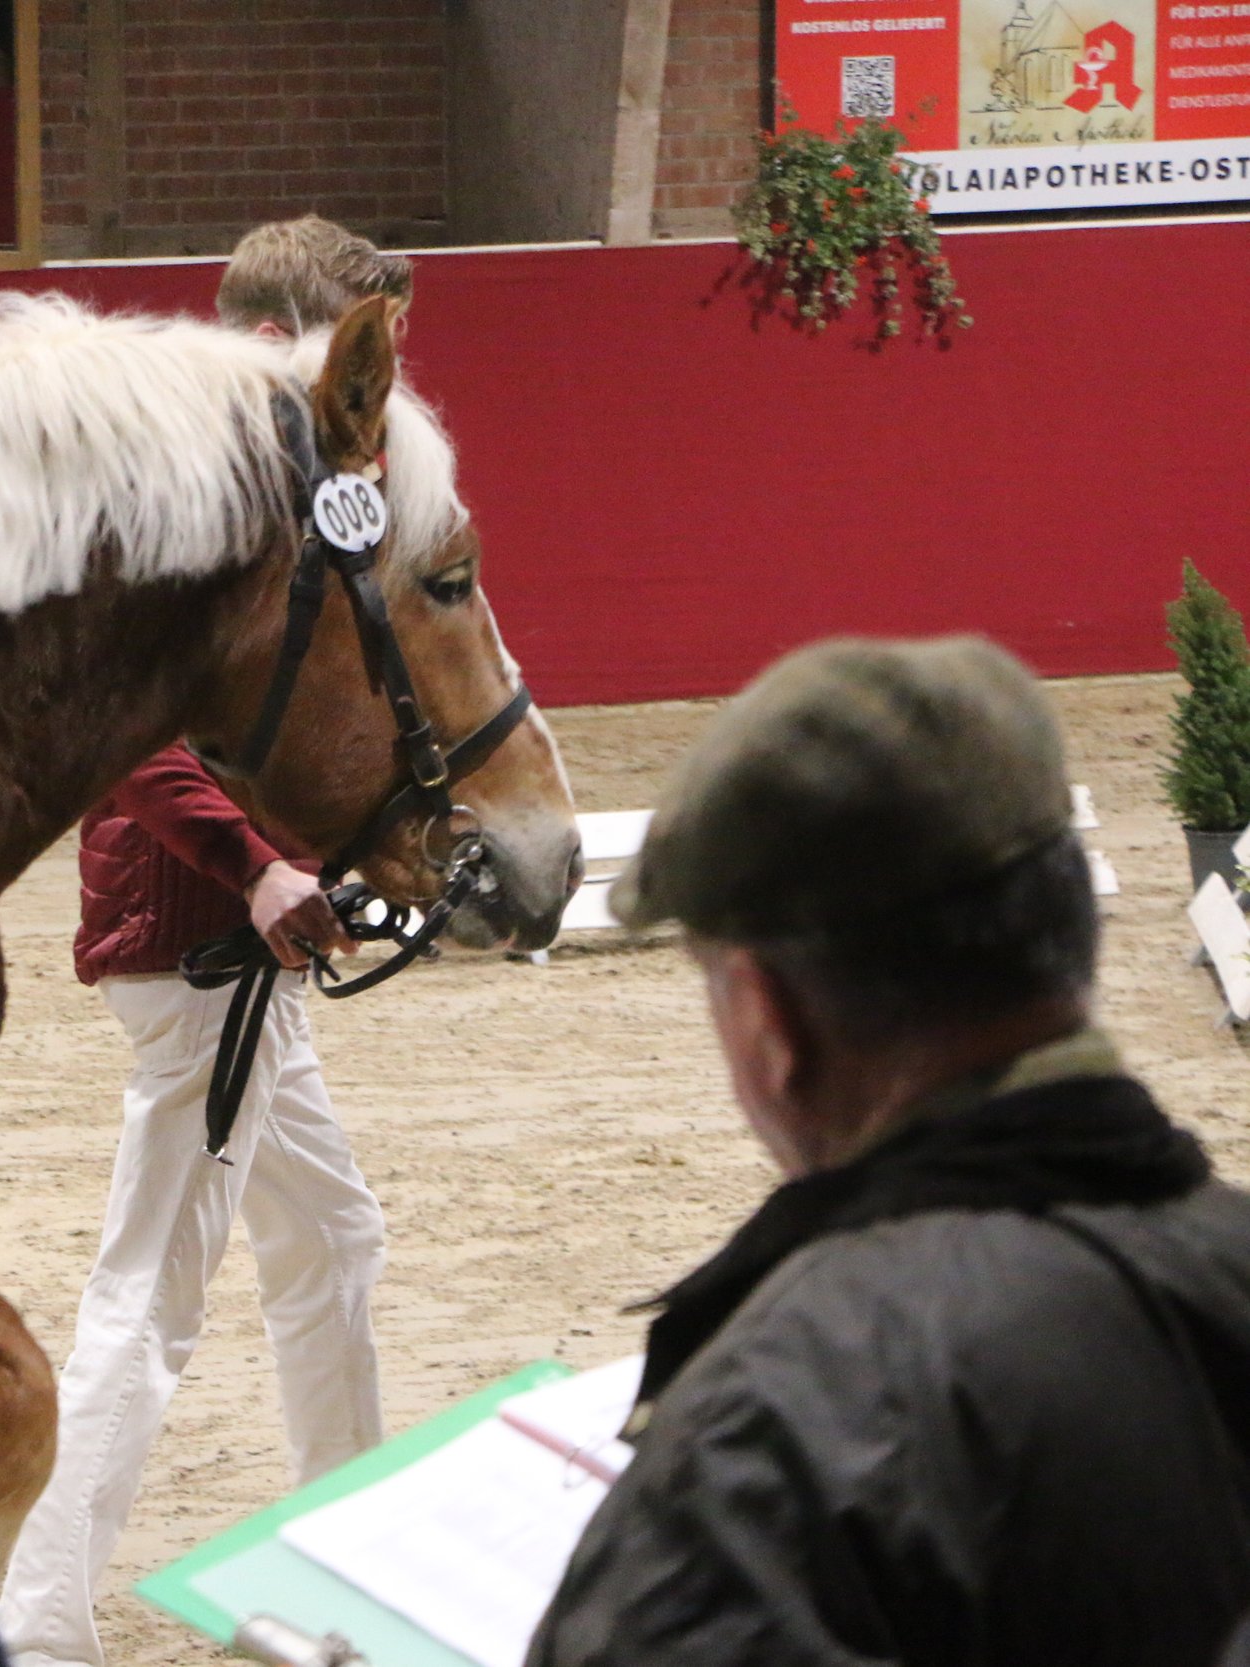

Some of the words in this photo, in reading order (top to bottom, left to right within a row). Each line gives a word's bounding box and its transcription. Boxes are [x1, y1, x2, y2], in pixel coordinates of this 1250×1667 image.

[1170, 4, 1195, 19] FÜR
[1197, 6, 1230, 18] DICH
[791, 20, 871, 34] KOSTENLOS
[873, 17, 946, 31] GELIEFERT!
[322, 483, 380, 542] 008
